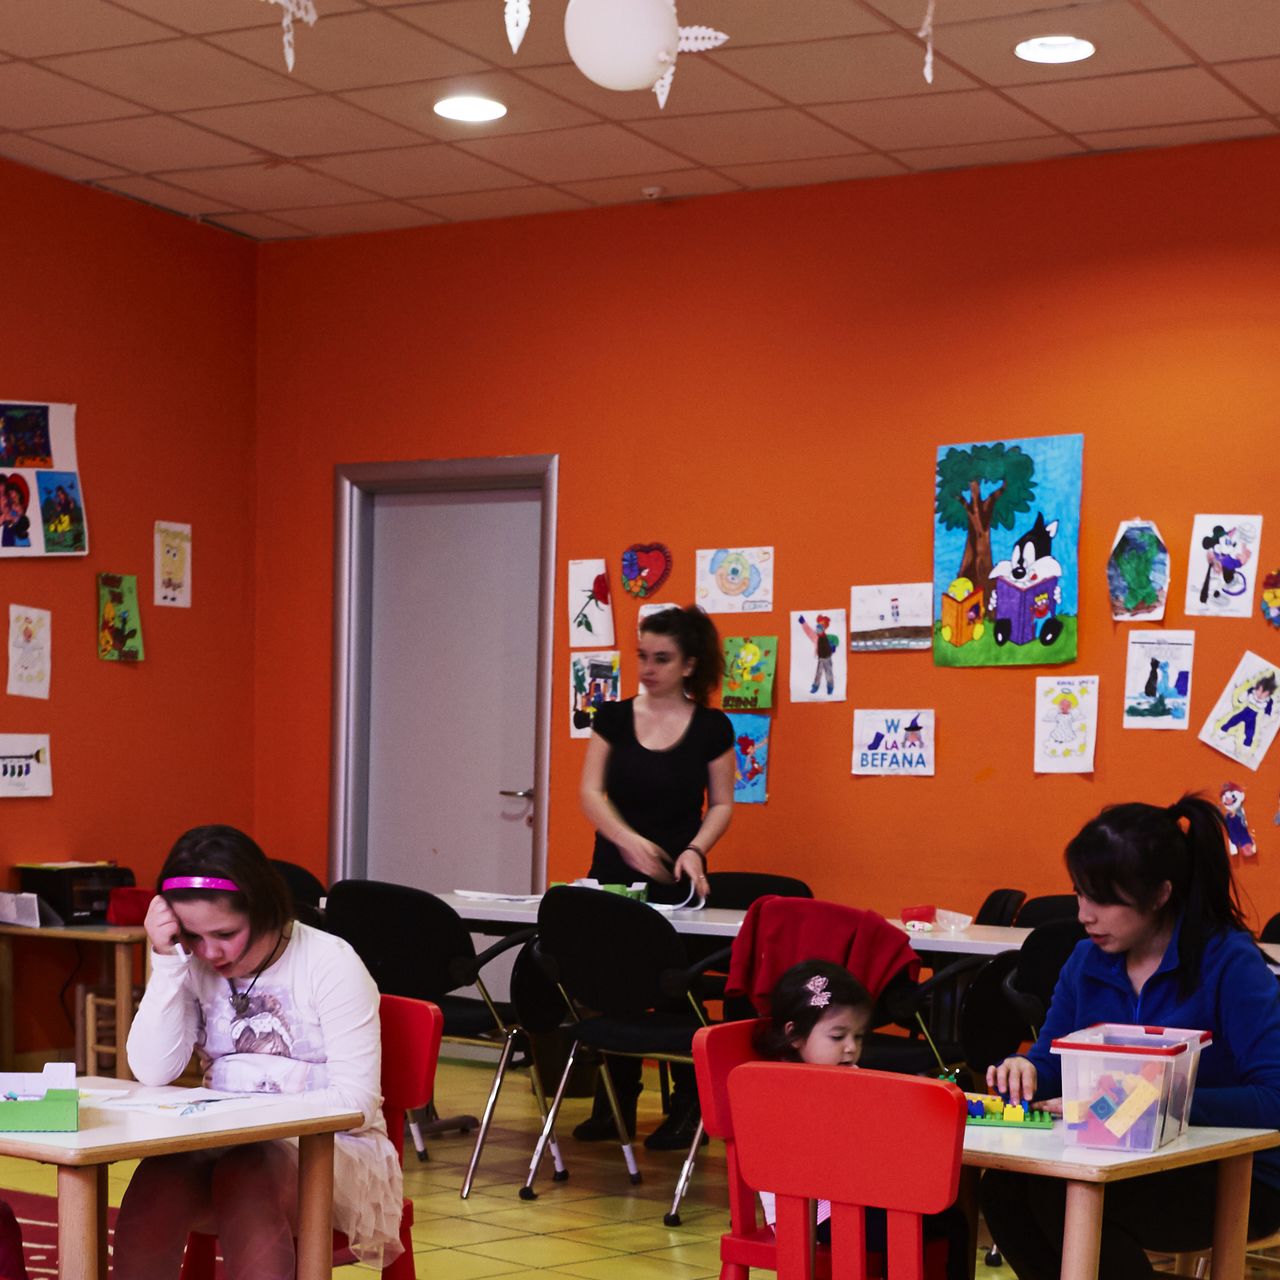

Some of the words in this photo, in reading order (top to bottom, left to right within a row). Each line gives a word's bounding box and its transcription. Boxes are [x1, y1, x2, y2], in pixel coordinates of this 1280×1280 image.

[885, 718, 901, 733] W
[885, 740, 899, 750] LA
[860, 752, 926, 768] BEFANA
